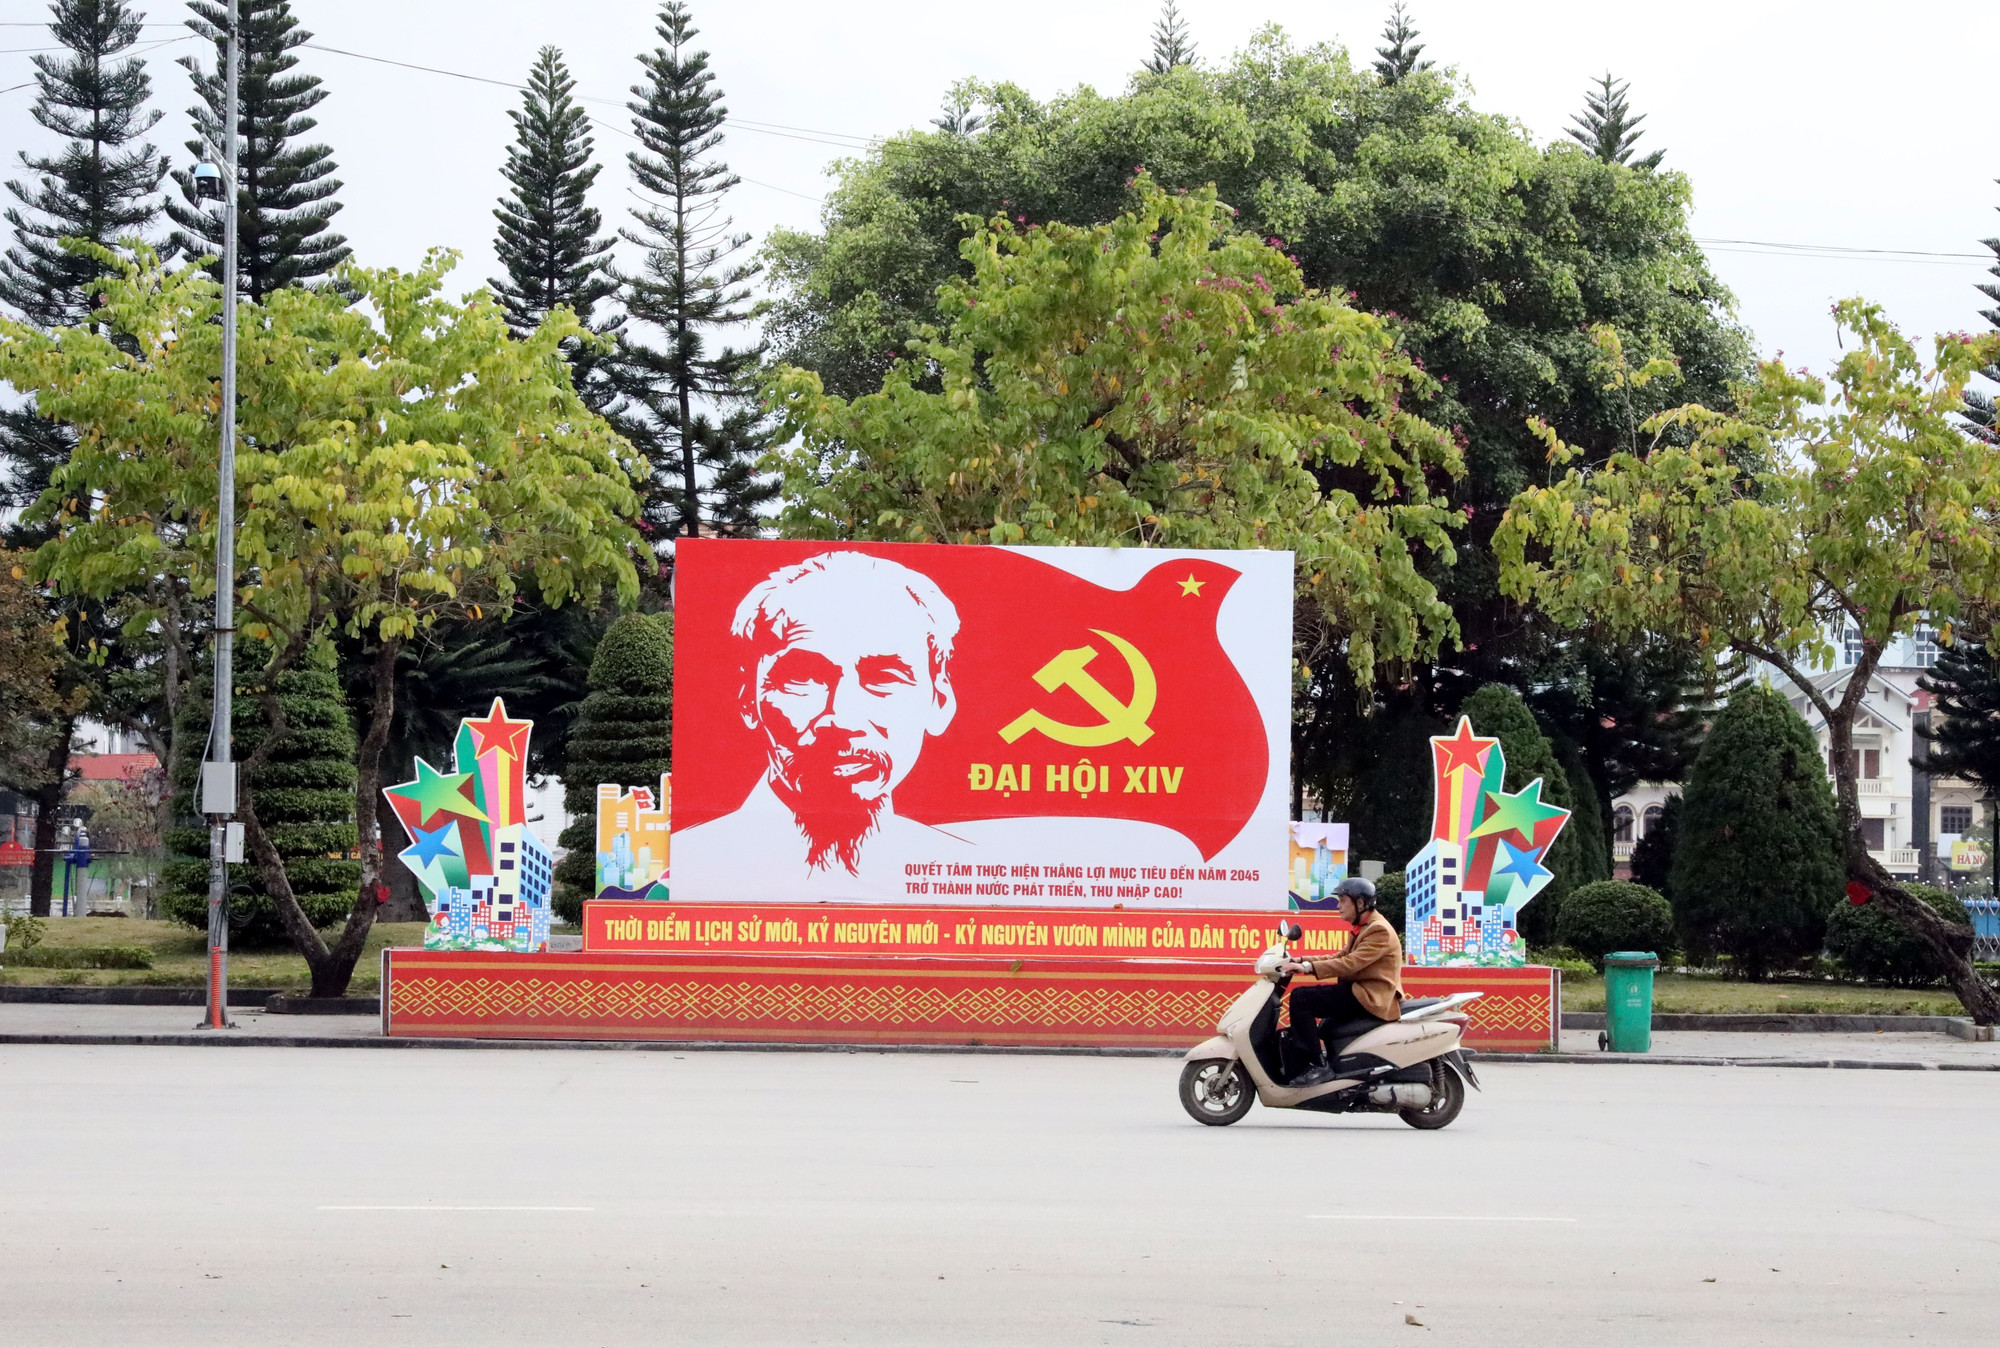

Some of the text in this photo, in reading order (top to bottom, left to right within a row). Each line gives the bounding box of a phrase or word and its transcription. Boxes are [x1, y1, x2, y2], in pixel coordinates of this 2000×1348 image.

[968, 758, 1185, 799] ĐẠI HỘI XIV
[905, 859, 1260, 882] QUYẾT TÂM THỰC HIỆN THẮNG LỢI MỤC TIÊU ĐẾN NĂM 2045
[905, 878, 1183, 900] TRỞ THÀNH NƯỚC PHÁT TRIỂN, THU NHẬP CAO!
[605, 915, 642, 941] THỜI
[647, 912, 690, 941] ĐIỂM
[695, 920, 733, 946] LỊCH
[737, 914, 762, 942] SỬ
[765, 918, 803, 945] MỚI,
[808, 915, 829, 943] KỶ
[834, 919, 901, 944] NGUYÊN
[906, 920, 939, 945] MỚI
[955, 917, 976, 944] KỶ
[981, 921, 1048, 946] NGUYÊN
[1053, 923, 1098, 947] VƯƠN
[1102, 922, 1147, 947] MÌNH
[1152, 920, 1185, 948] CỦA
[1190, 924, 1224, 949] DÂN
[1229, 925, 1260, 953] TỘC
[1304, 930, 1348, 950] NAM!
